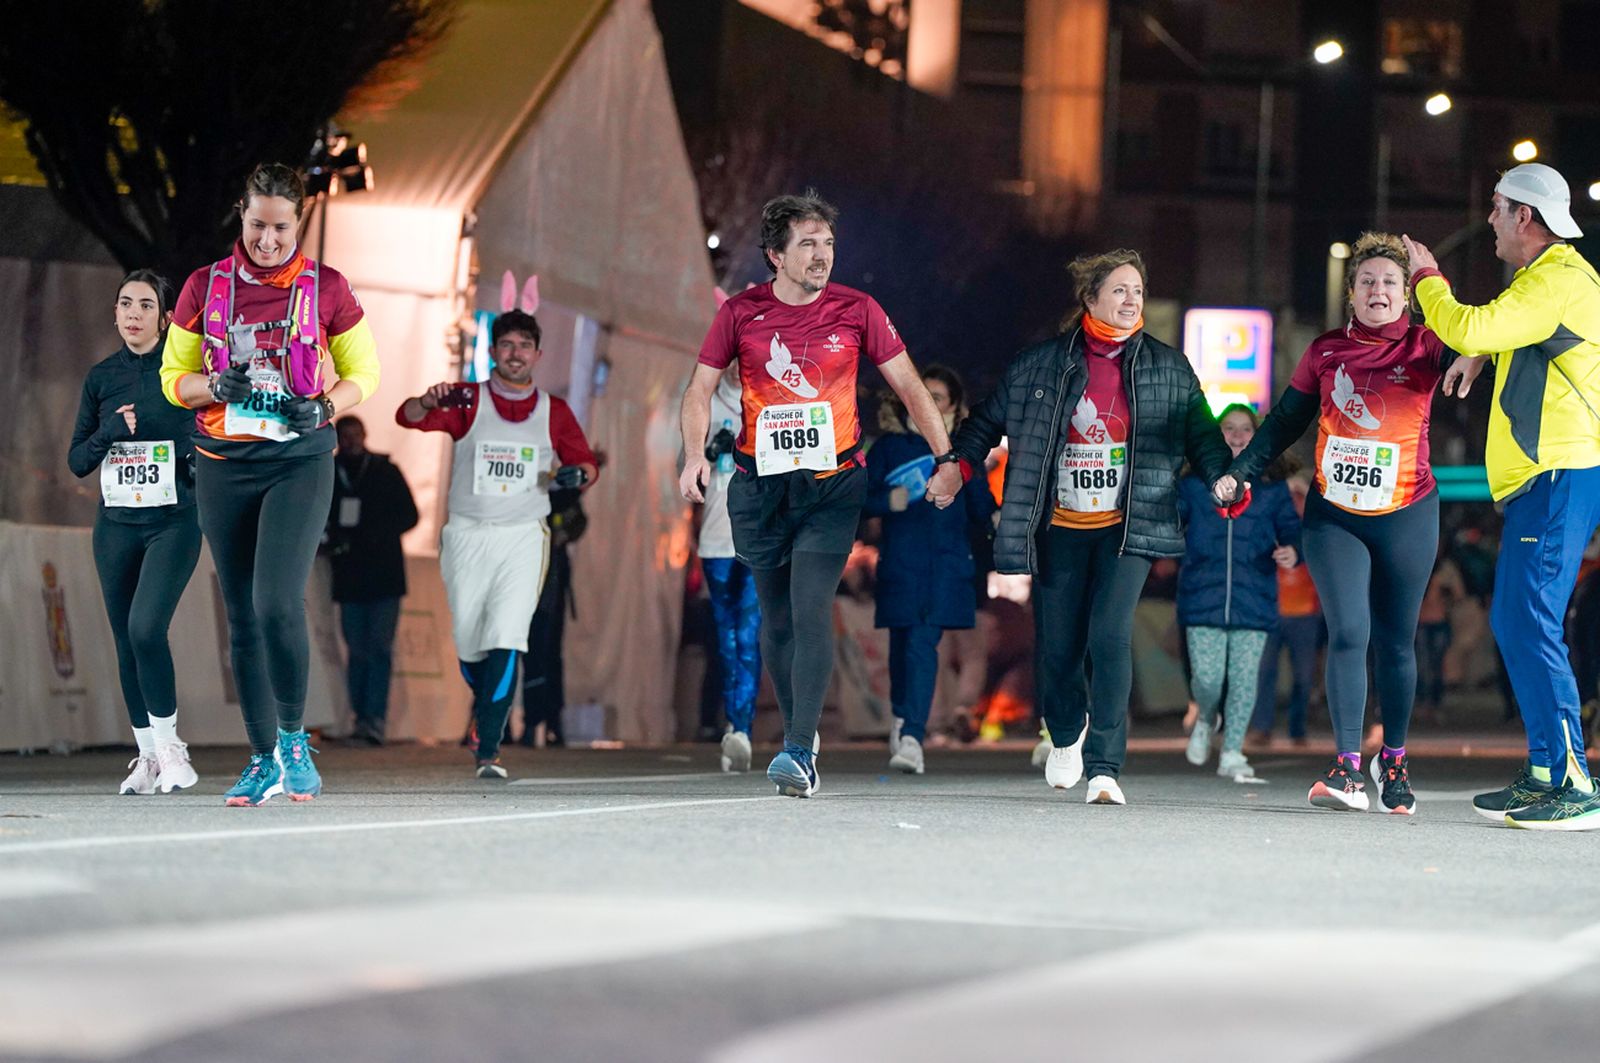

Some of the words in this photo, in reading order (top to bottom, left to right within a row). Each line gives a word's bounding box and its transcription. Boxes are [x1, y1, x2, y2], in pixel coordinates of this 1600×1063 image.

[781, 368, 802, 388] 43
[771, 411, 793, 420] NOCHE
[795, 410, 804, 419] DE
[1344, 398, 1364, 419] 43
[763, 421, 778, 430] SAN
[779, 419, 805, 430] ANTÓN
[770, 428, 820, 451] 1689
[1085, 424, 1106, 445] 43
[1072, 451, 1094, 459] NOCHE
[1094, 451, 1104, 459] DE
[1338, 445, 1359, 455] NOCHE
[1360, 448, 1370, 456] DE
[109, 457, 124, 465] SAN
[124, 455, 147, 465] ANTÓN
[1064, 460, 1078, 468] SAN
[1078, 458, 1105, 468] ANTÓN
[1343, 455, 1370, 465] ANTÓN
[115, 464, 160, 486] 1983
[487, 461, 526, 479] 7009
[1070, 468, 1118, 490] 1688
[1333, 462, 1383, 488] 3256
